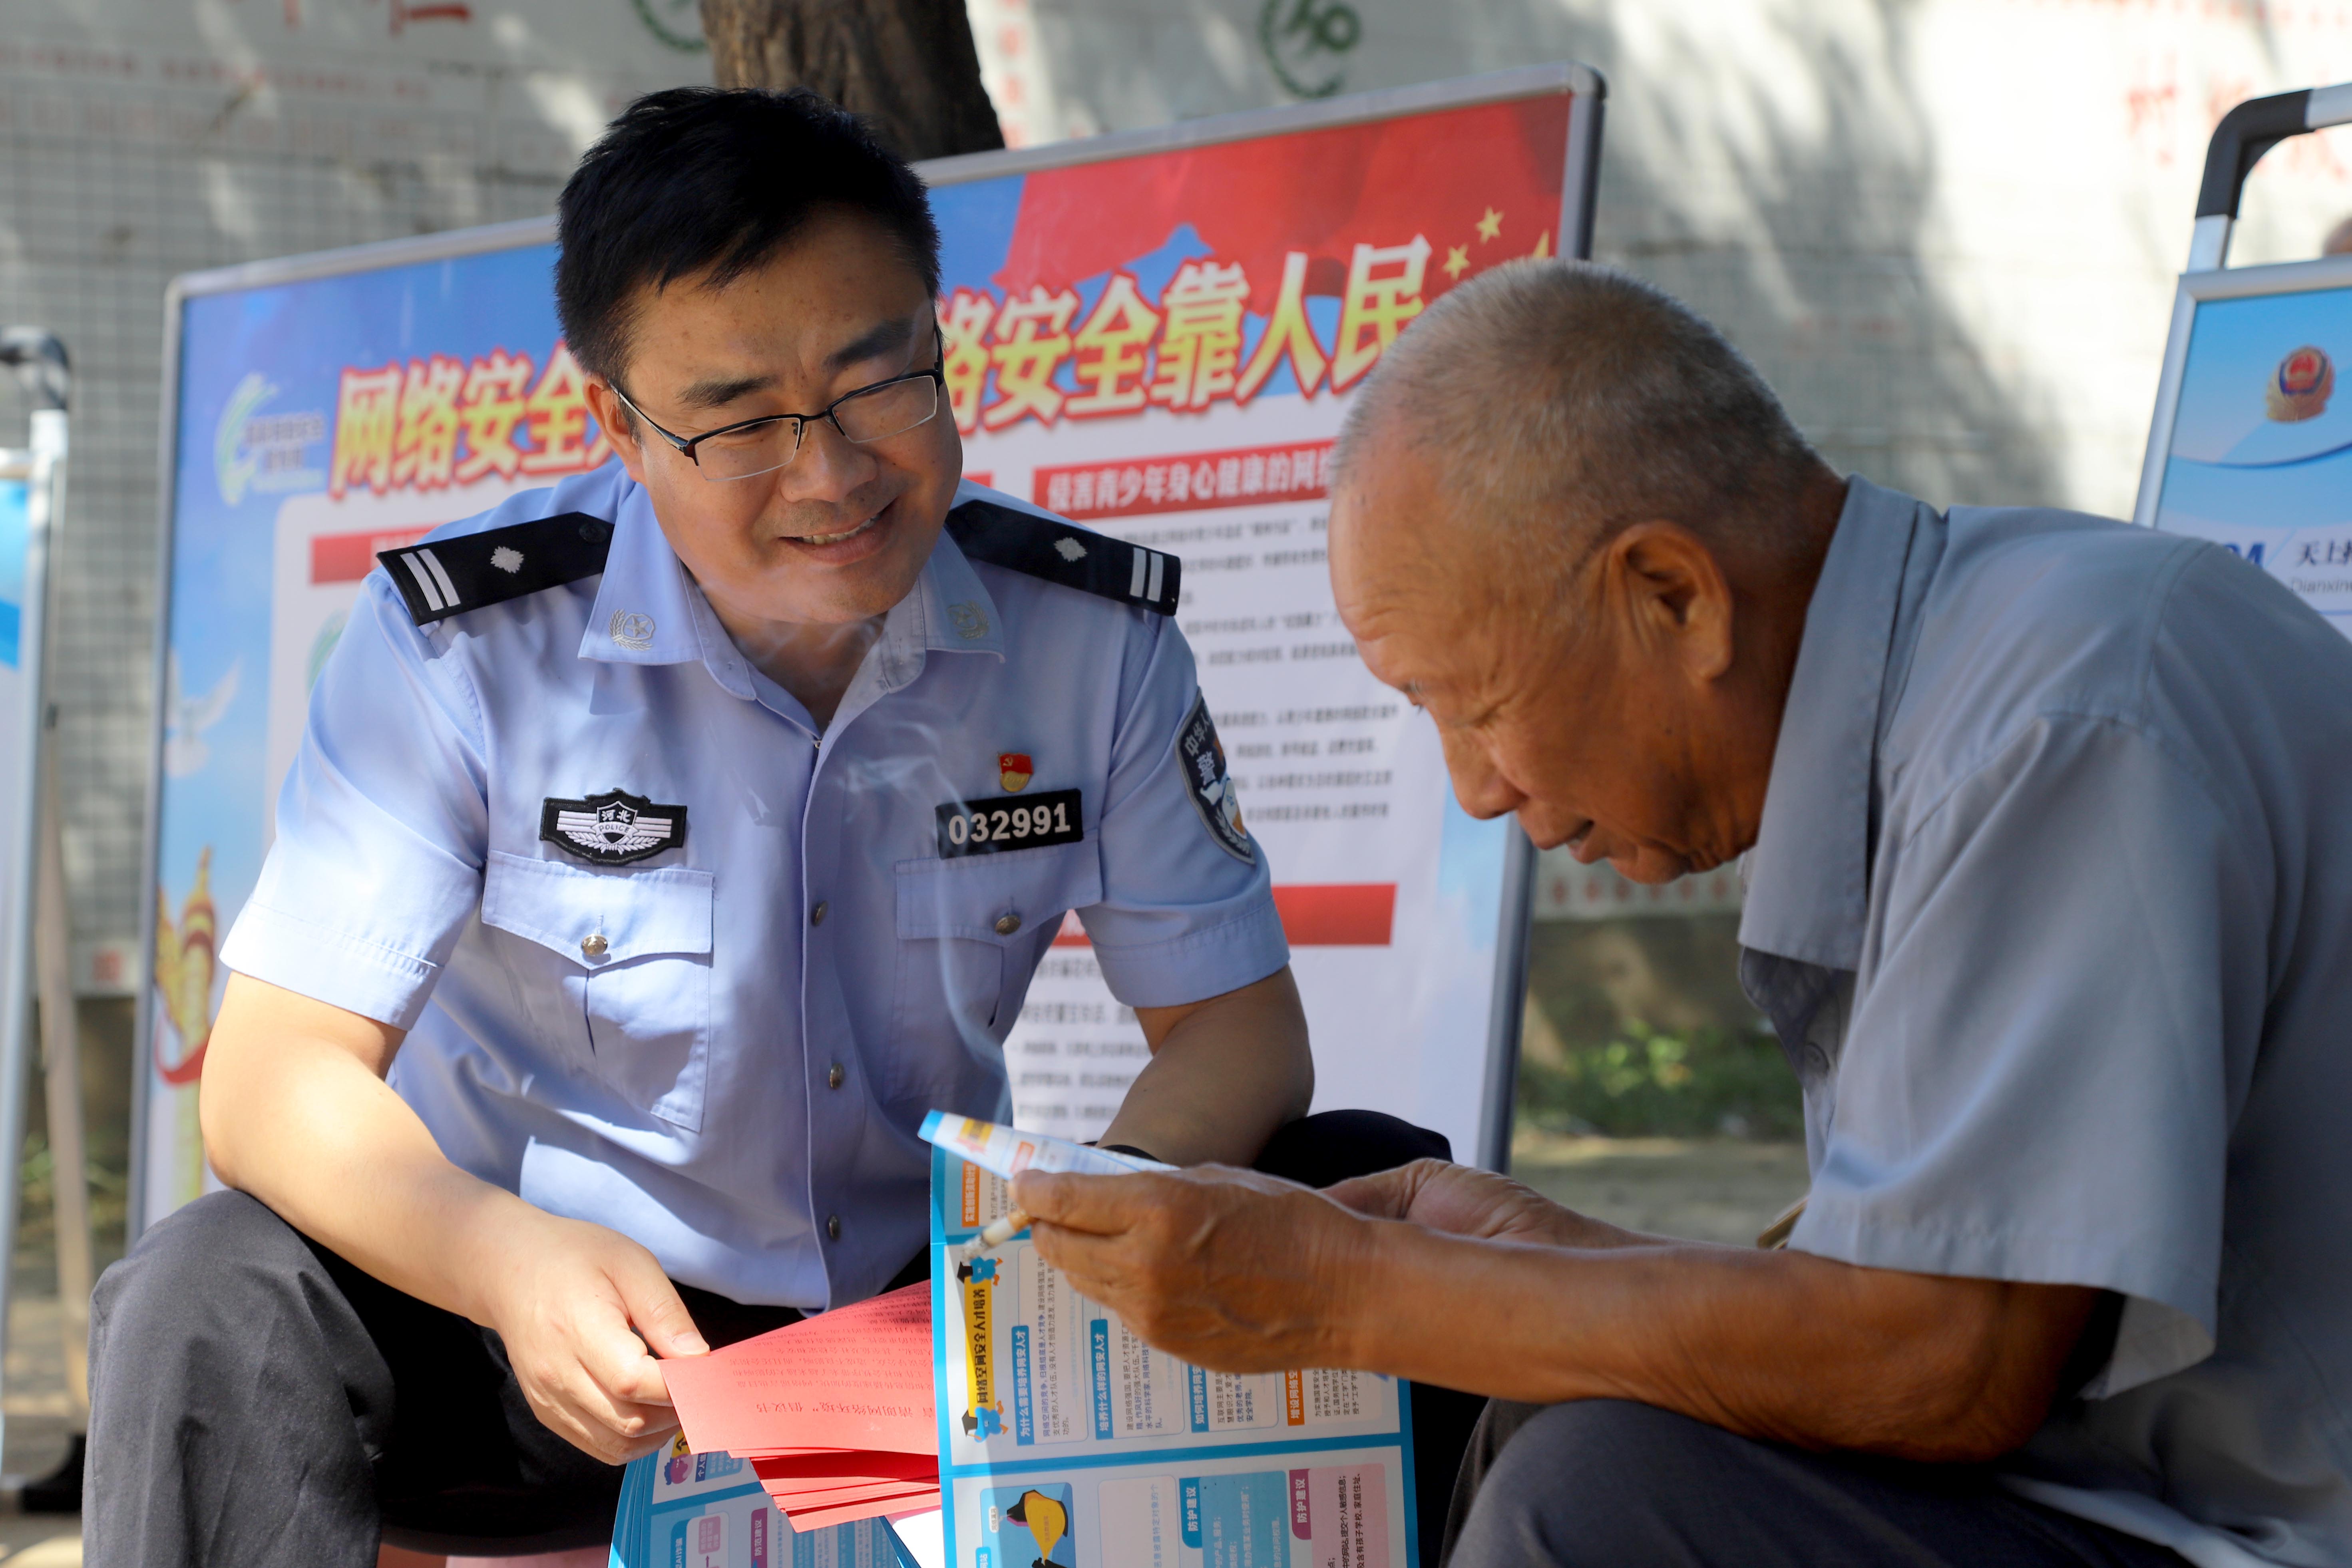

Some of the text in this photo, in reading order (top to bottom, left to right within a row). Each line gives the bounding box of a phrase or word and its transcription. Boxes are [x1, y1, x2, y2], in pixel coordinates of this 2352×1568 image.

[330, 343, 613, 497] 网络安全
[2291, 577, 2352, 593] Dianxin
[601, 809, 631, 822] 河北
[949, 803, 1071, 845] 032991
[973, 1289, 988, 1403] 网络空间安全人才培养
[1016, 1331, 1030, 1437] 为什么需要培养网安人才
[1094, 1333, 1109, 1431] 培养什么样的网安人才
[1192, 1366, 1204, 1424] 如何培养网安
[1245, 1389, 1253, 1422] 安全学院。
[1288, 1370, 1300, 1419] 增设网络空
[1313, 1369, 1321, 1417] 为实施国家安全
[1186, 1487, 1198, 1531] 防护建议
[1295, 1479, 1307, 1523] 防护建议
[1240, 1486, 1252, 1568] 限办理某业务时使用”；
